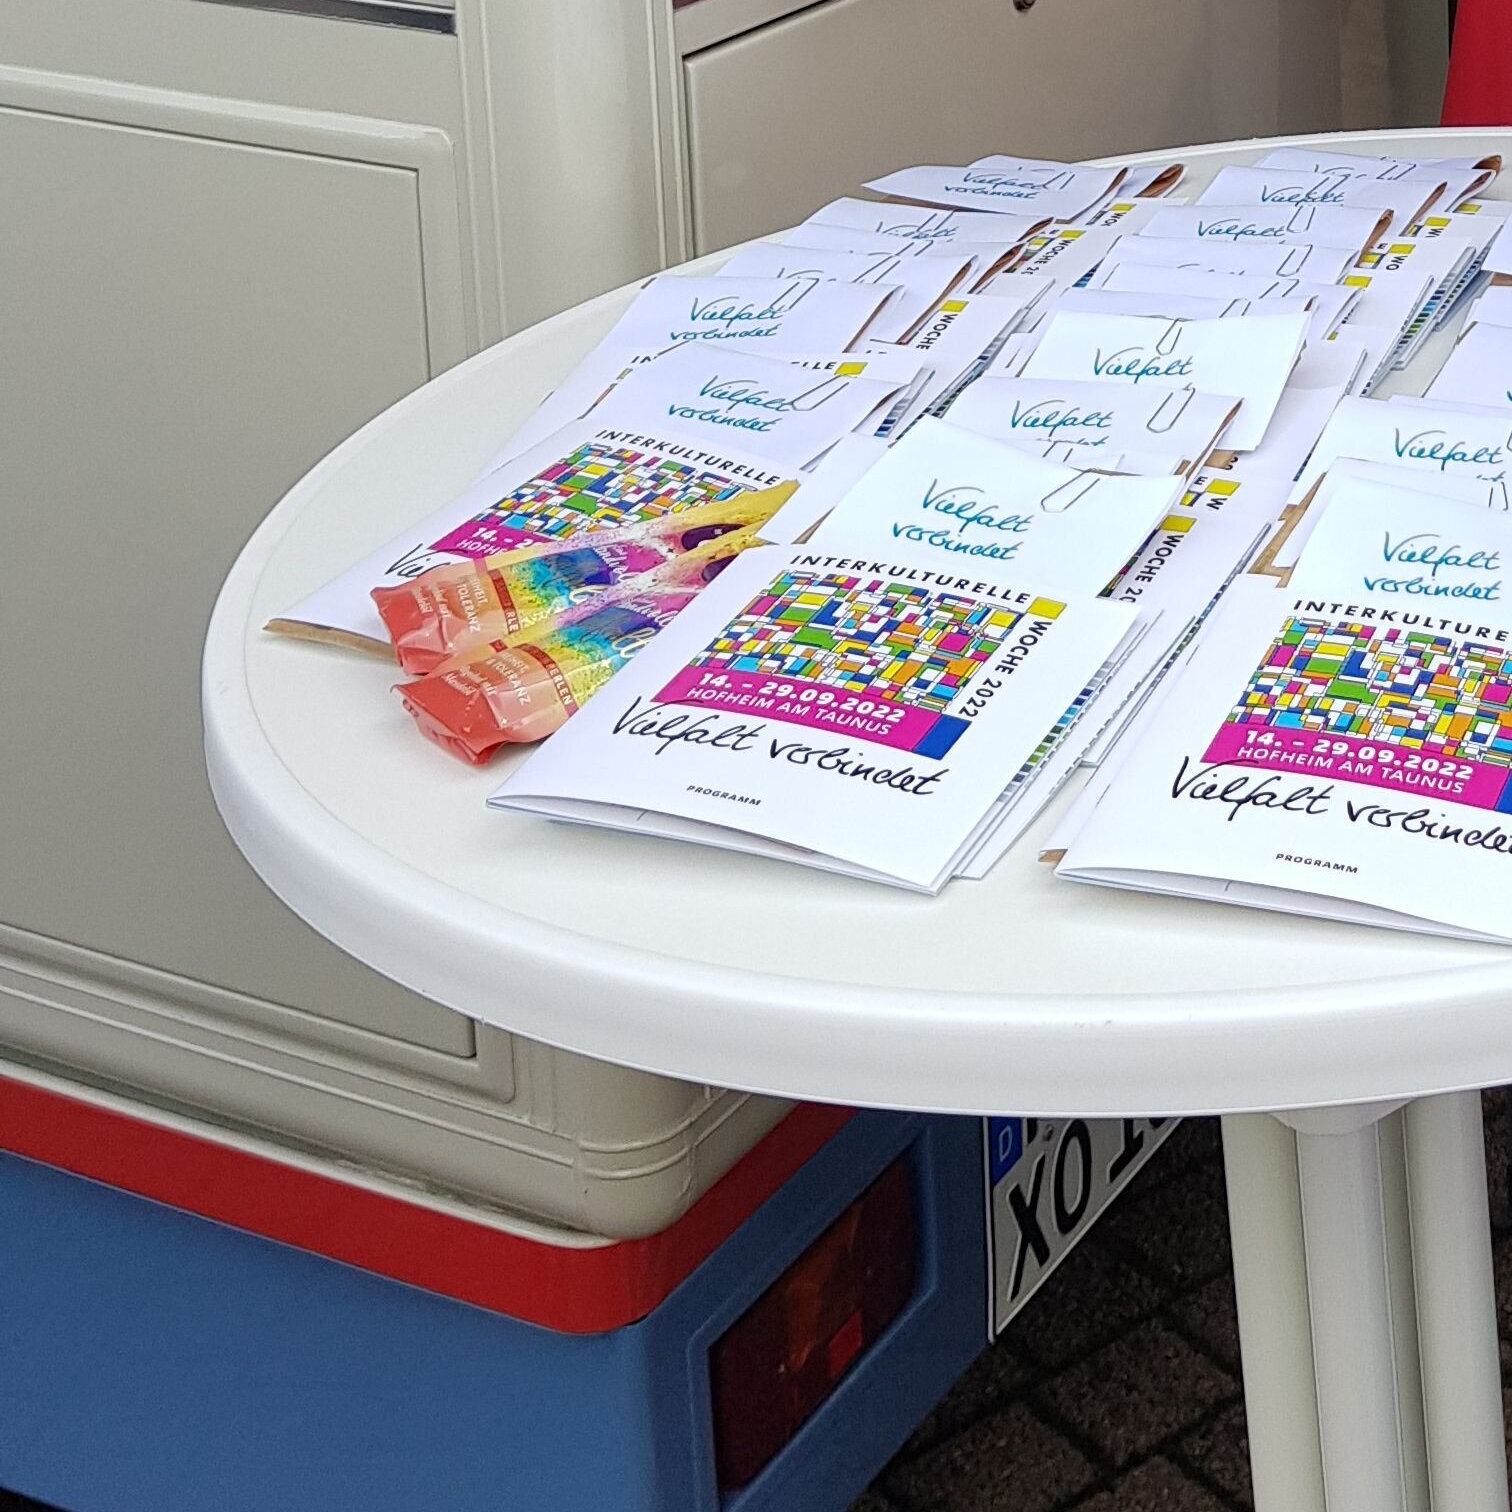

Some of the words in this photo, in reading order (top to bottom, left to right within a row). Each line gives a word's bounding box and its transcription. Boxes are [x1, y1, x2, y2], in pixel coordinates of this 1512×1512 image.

[1034, 238, 1076, 265] WOCHE
[1198, 219, 1288, 240] Vielfalt
[670, 322, 782, 341] verbindet
[691, 296, 783, 329] Vielfalt
[916, 313, 958, 350] WOCHE
[1094, 347, 1194, 383] Vielfalt
[700, 375, 793, 414] Vielfalt
[668, 403, 783, 433] verbindet
[1011, 400, 1112, 437] Vielfalt
[595, 428, 782, 487] INTERKULTURELLE
[1395, 427, 1504, 471] Vielfalt
[922, 478, 1035, 538] Vielfalt
[892, 521, 1019, 562] verbindet
[1135, 534, 1184, 584] WOCHE
[1382, 531, 1501, 581] Vielfalt
[790, 554, 1031, 604] INTERKULTURELLE
[1364, 576, 1503, 602] verbindet
[455, 582, 481, 633] TOLERANZ
[997, 620, 1053, 675] WOCHE
[493, 661, 531, 705] TOLERANZ
[698, 671, 732, 692] 14.
[765, 680, 907, 723] 29.09.2022
[959, 678, 1004, 718] 2022
[686, 685, 773, 712] HOFHEIM
[776, 701, 810, 719] AM
[814, 706, 892, 737] TAUNUS
[612, 694, 768, 756] Vielfalt
[769, 737, 949, 797] verbindet
[1244, 729, 1282, 749] 14.
[1316, 737, 1475, 781] 29.09.2022
[1170, 755, 1336, 822] Vielfalt
[1237, 744, 1334, 771] HOFHEIM
[1338, 757, 1375, 775] AM
[1379, 765, 1466, 795] TAUNUS
[686, 784, 762, 808] PROGRAMM
[1274, 851, 1359, 875] PROGRAMM
[999, 1124, 1013, 1162] D
[1006, 1119, 1093, 1301] XO
